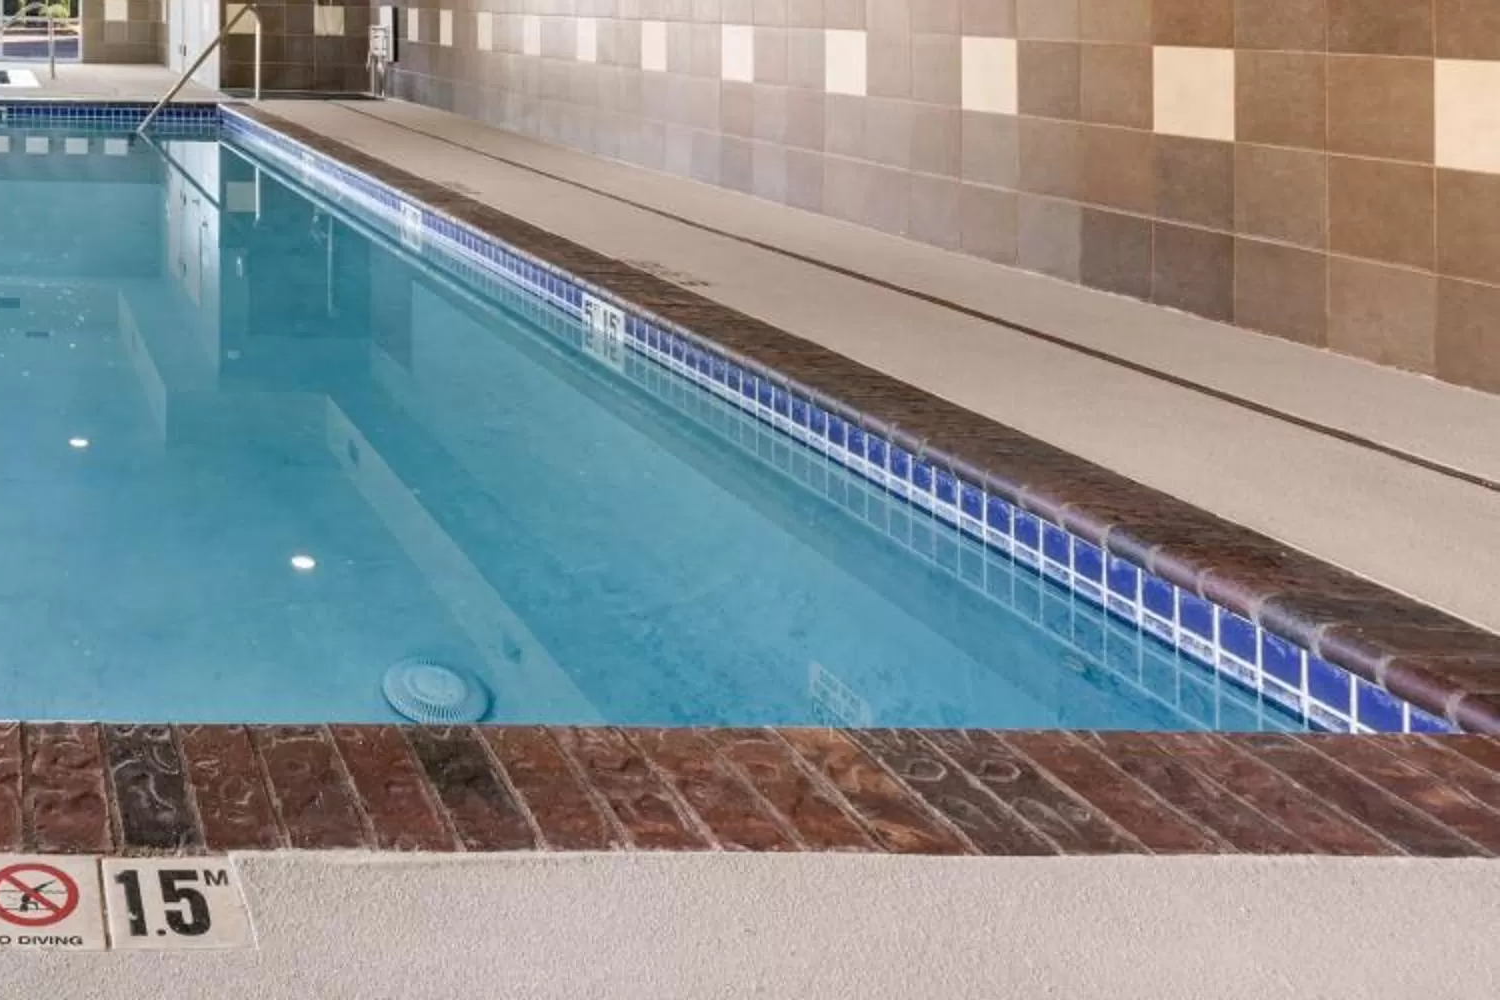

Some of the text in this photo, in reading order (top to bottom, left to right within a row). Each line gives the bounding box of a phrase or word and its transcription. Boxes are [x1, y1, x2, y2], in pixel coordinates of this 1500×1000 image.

[114, 869, 229, 937] 1.5 M
[18, 935, 84, 946] DIVING
